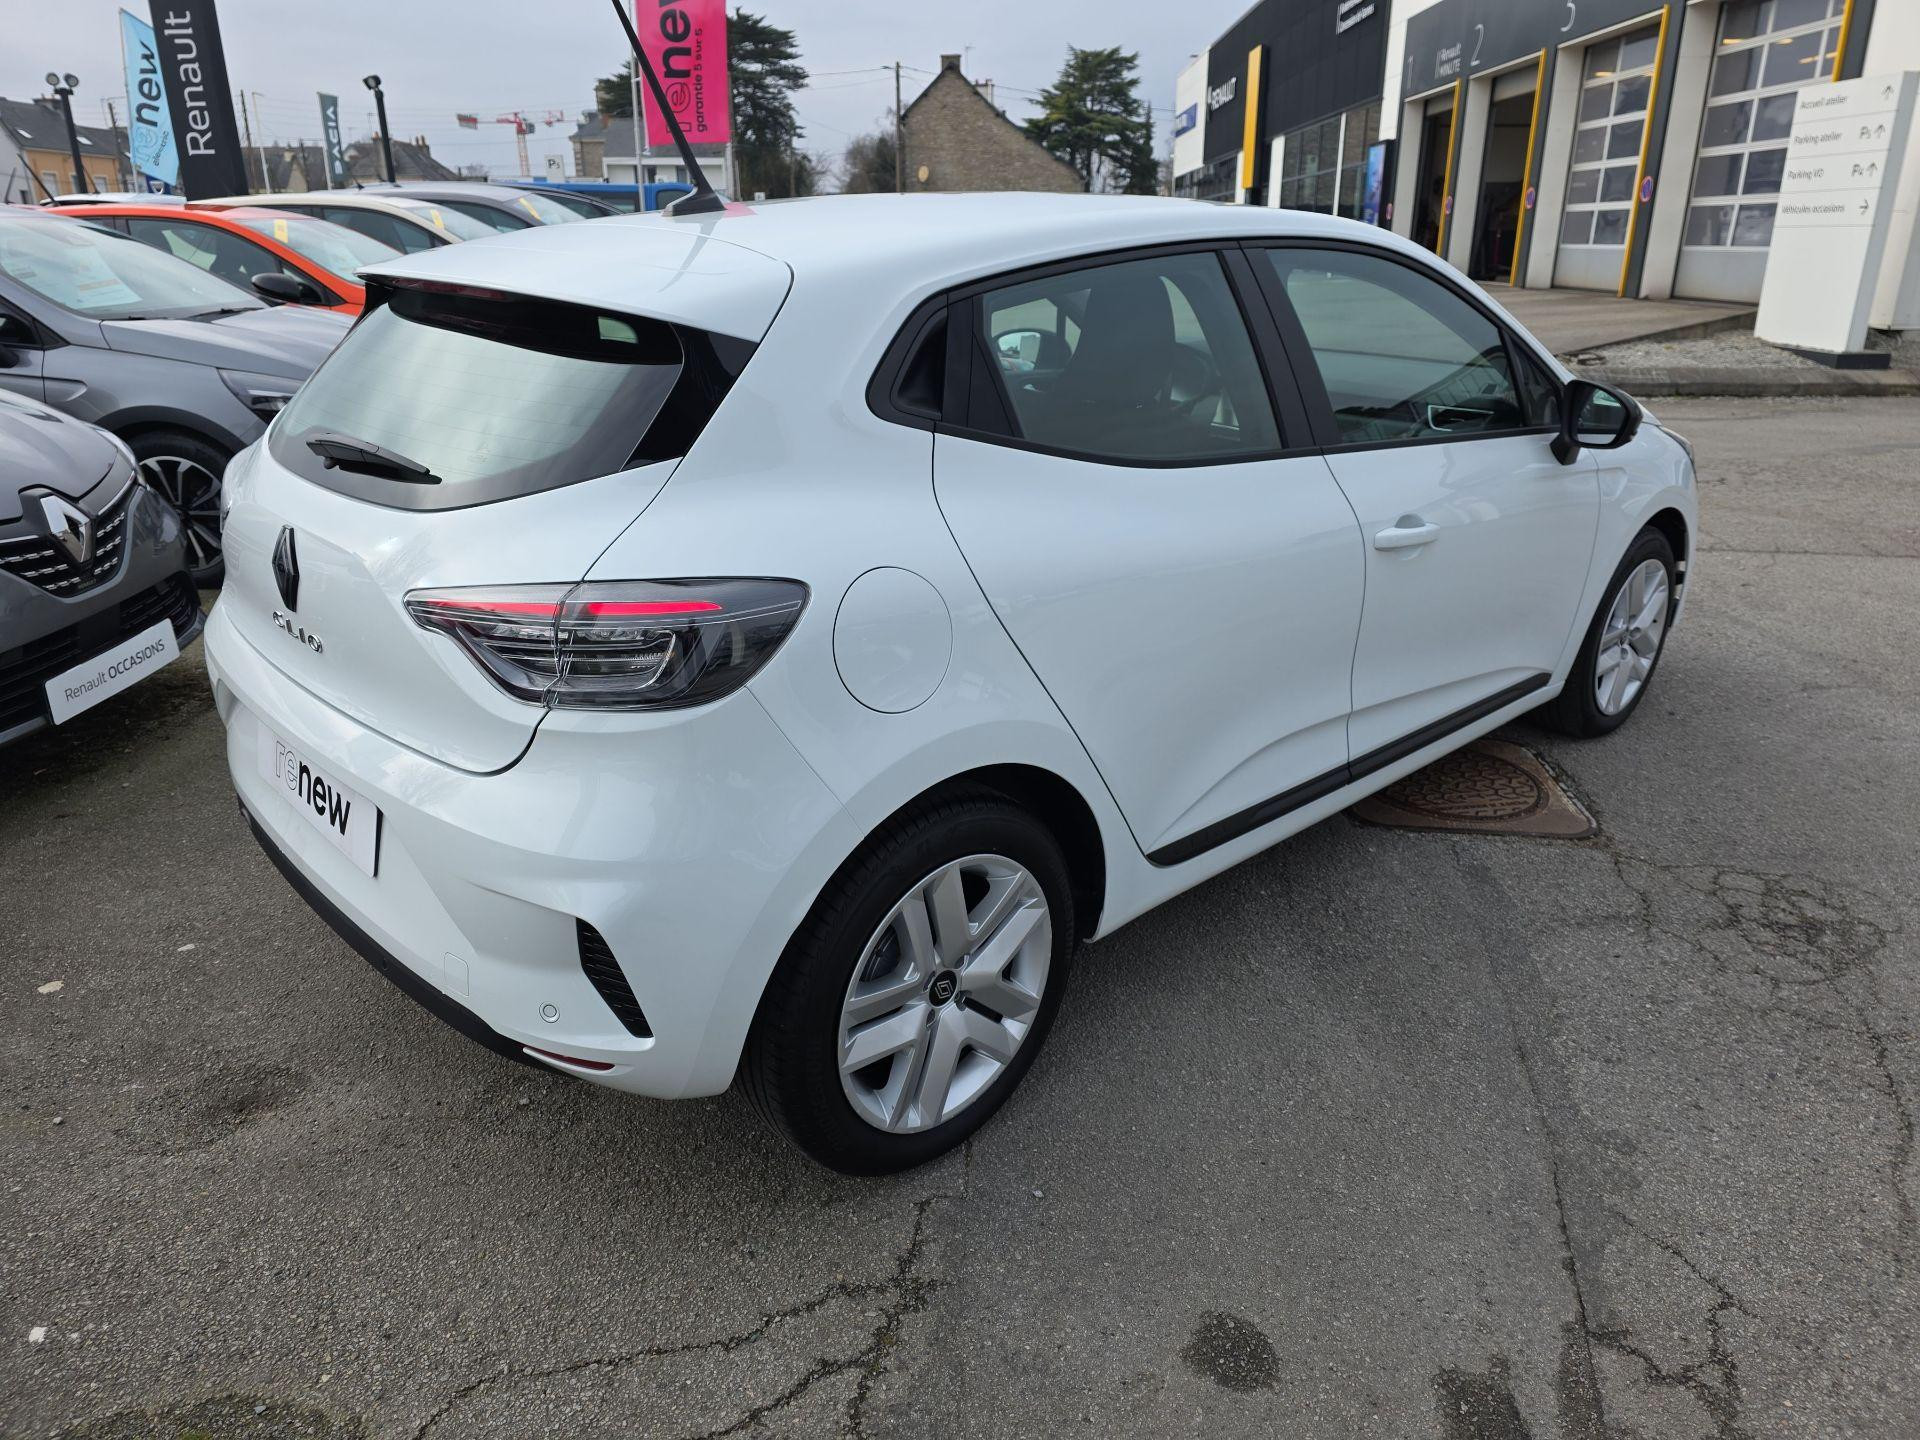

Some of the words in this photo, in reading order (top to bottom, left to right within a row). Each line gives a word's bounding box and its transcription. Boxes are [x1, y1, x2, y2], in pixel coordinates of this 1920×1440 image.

[695, 28, 702, 37] 5
[1471, 23, 1484, 66] 2
[164, 10, 215, 157] Renault
[659, 0, 691, 133] ene
[695, 63, 702, 71] 5
[693, 75, 707, 132] garantie
[1800, 97, 1824, 109] Accueil
[1825, 96, 1847, 105] atelier
[1794, 134, 1818, 145] Parking
[1820, 131, 1842, 142] atelier
[1787, 169, 1812, 180] Parking
[272, 610, 324, 654] CLIO
[64, 672, 107, 702] Renault
[108, 638, 165, 679] OCCASIONS
[274, 740, 351, 836] renew
